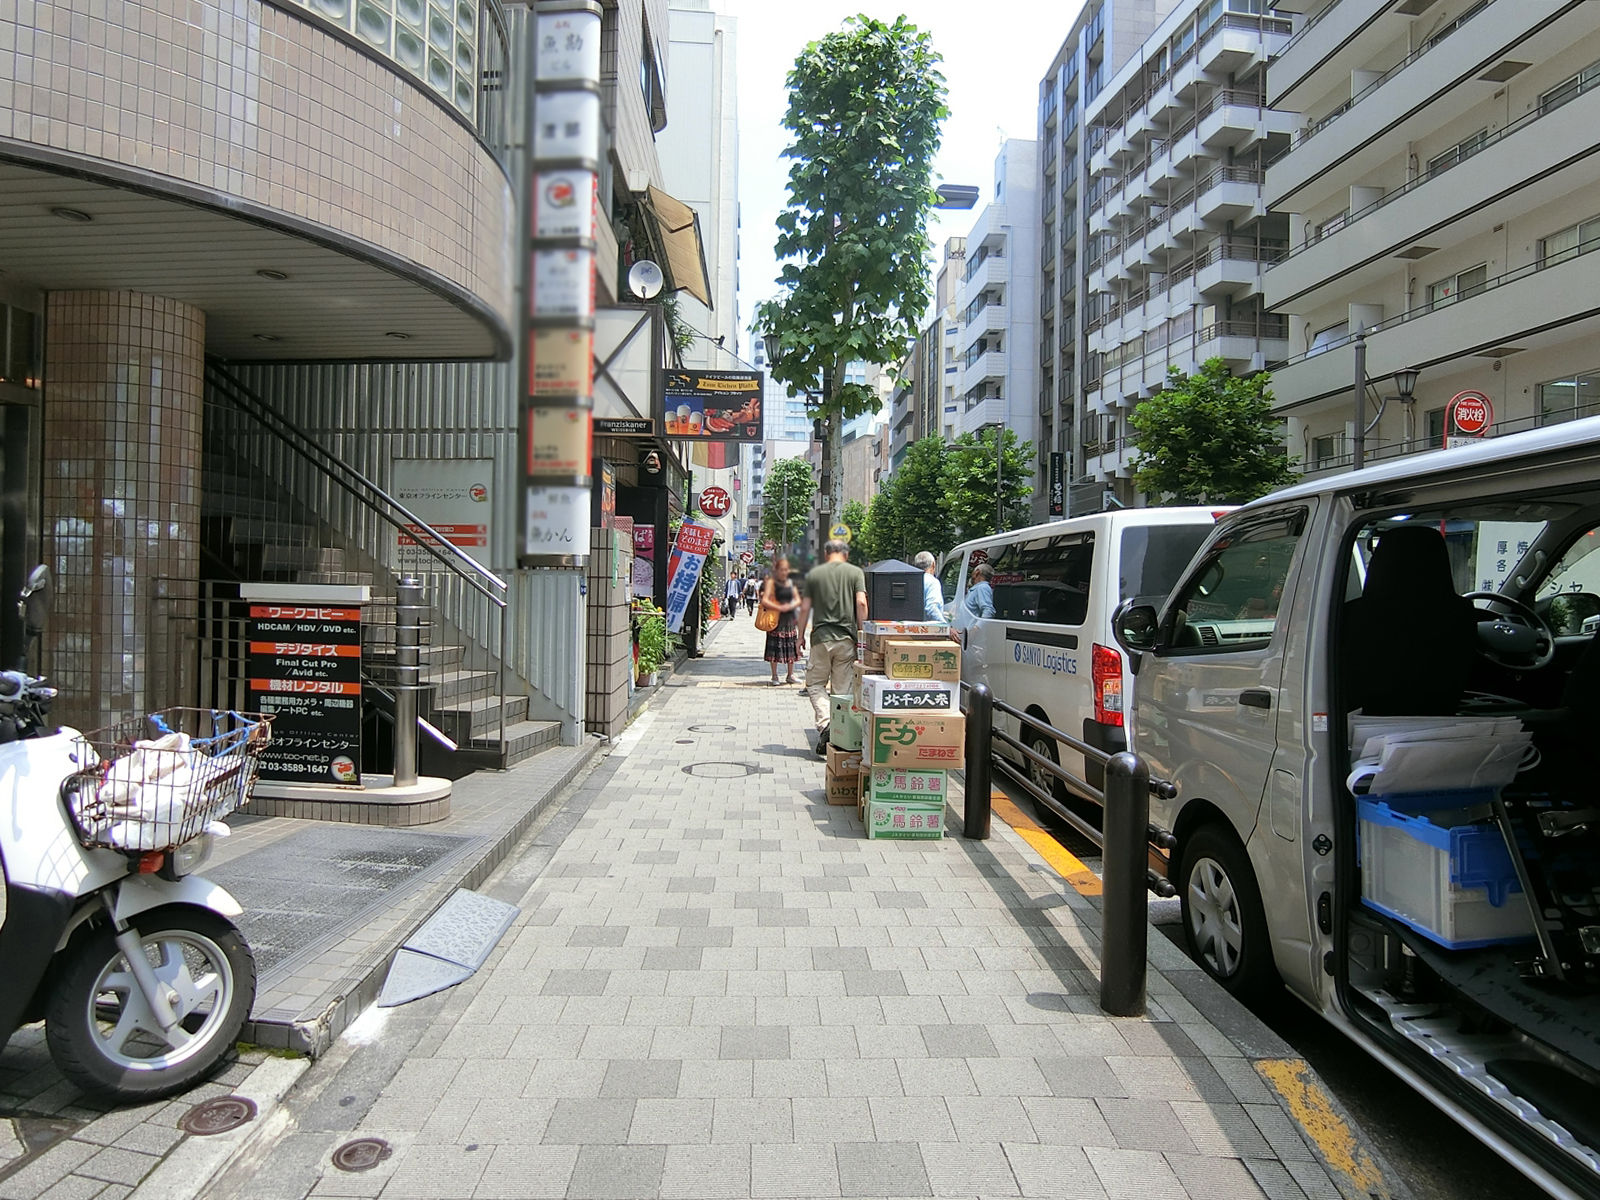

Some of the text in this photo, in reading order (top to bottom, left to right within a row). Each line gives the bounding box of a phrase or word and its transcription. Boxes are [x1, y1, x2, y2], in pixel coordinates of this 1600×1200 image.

[1457, 407, 1484, 422] 消火栓
[600, 420, 647, 429] Franziskaner
[702, 494, 728, 510] そば
[681, 534, 710, 548] そのまま
[268, 606, 344, 620] ワークコピー
[275, 642, 338, 656] デジタイズ
[301, 659, 319, 668] Cut
[320, 660, 338, 668] Pro
[1022, 645, 1077, 675] SANYO Logistics
[269, 678, 344, 693] 機材レンタル
[918, 747, 957, 759] たまねぎ
[267, 762, 329, 774] 03-3589-1647
[893, 775, 942, 792] 馬鈴薯
[892, 813, 941, 829] 馬鈴薯
